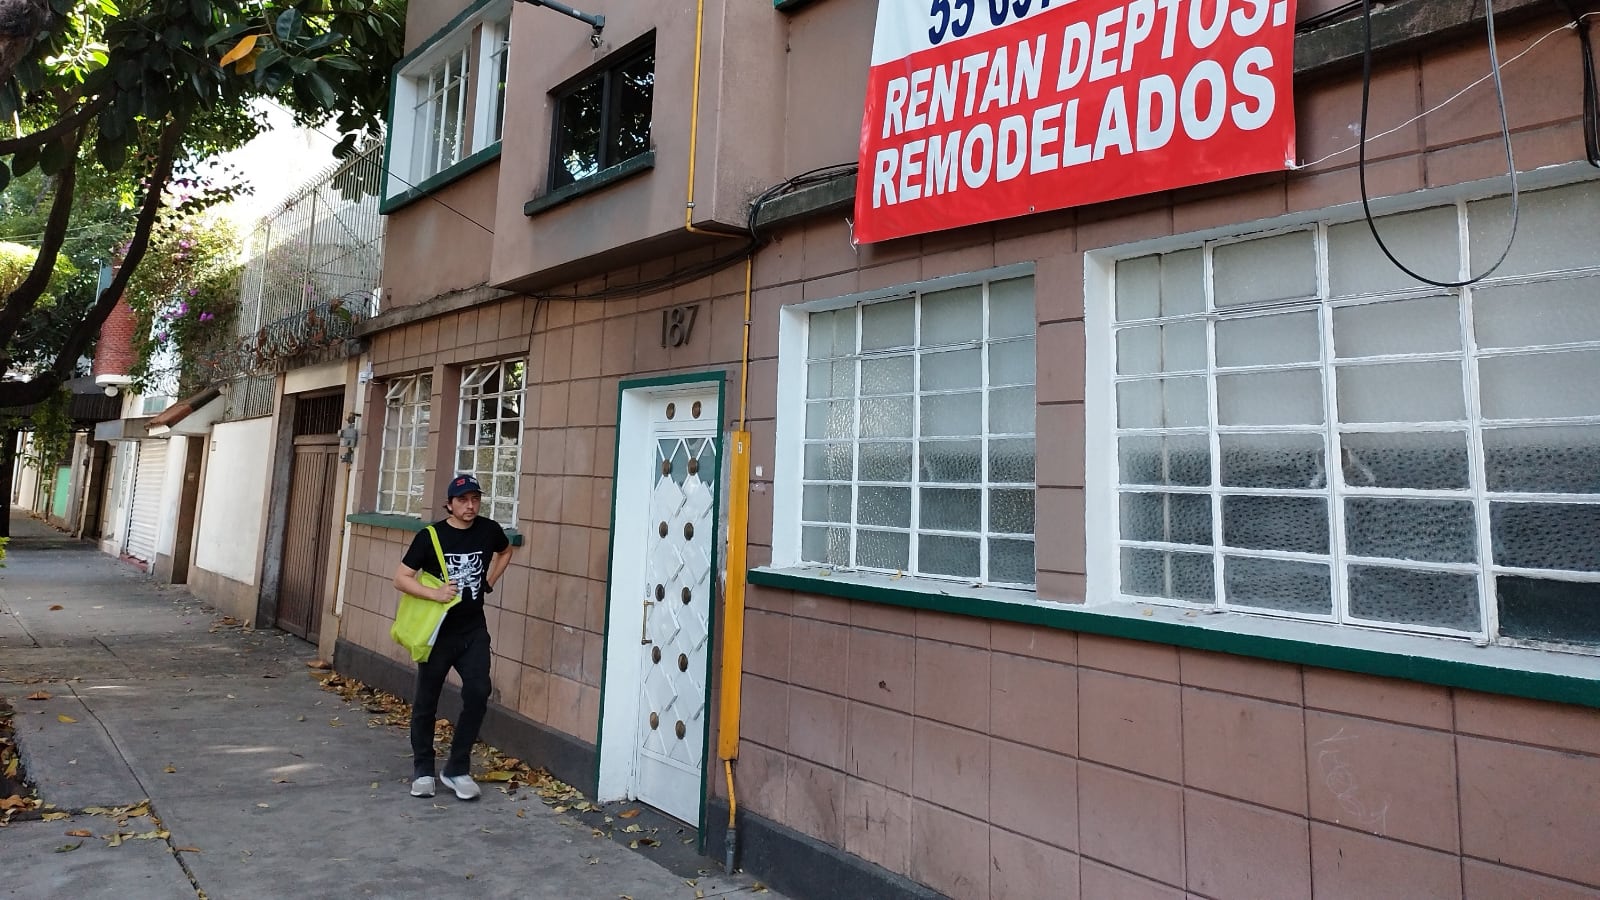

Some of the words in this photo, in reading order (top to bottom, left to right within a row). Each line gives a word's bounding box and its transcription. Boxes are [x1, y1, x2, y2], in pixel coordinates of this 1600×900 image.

[872, 46, 1277, 210] REMODELADOS
[881, 34, 1048, 140] RENTAN
[660, 304, 700, 349] 187
